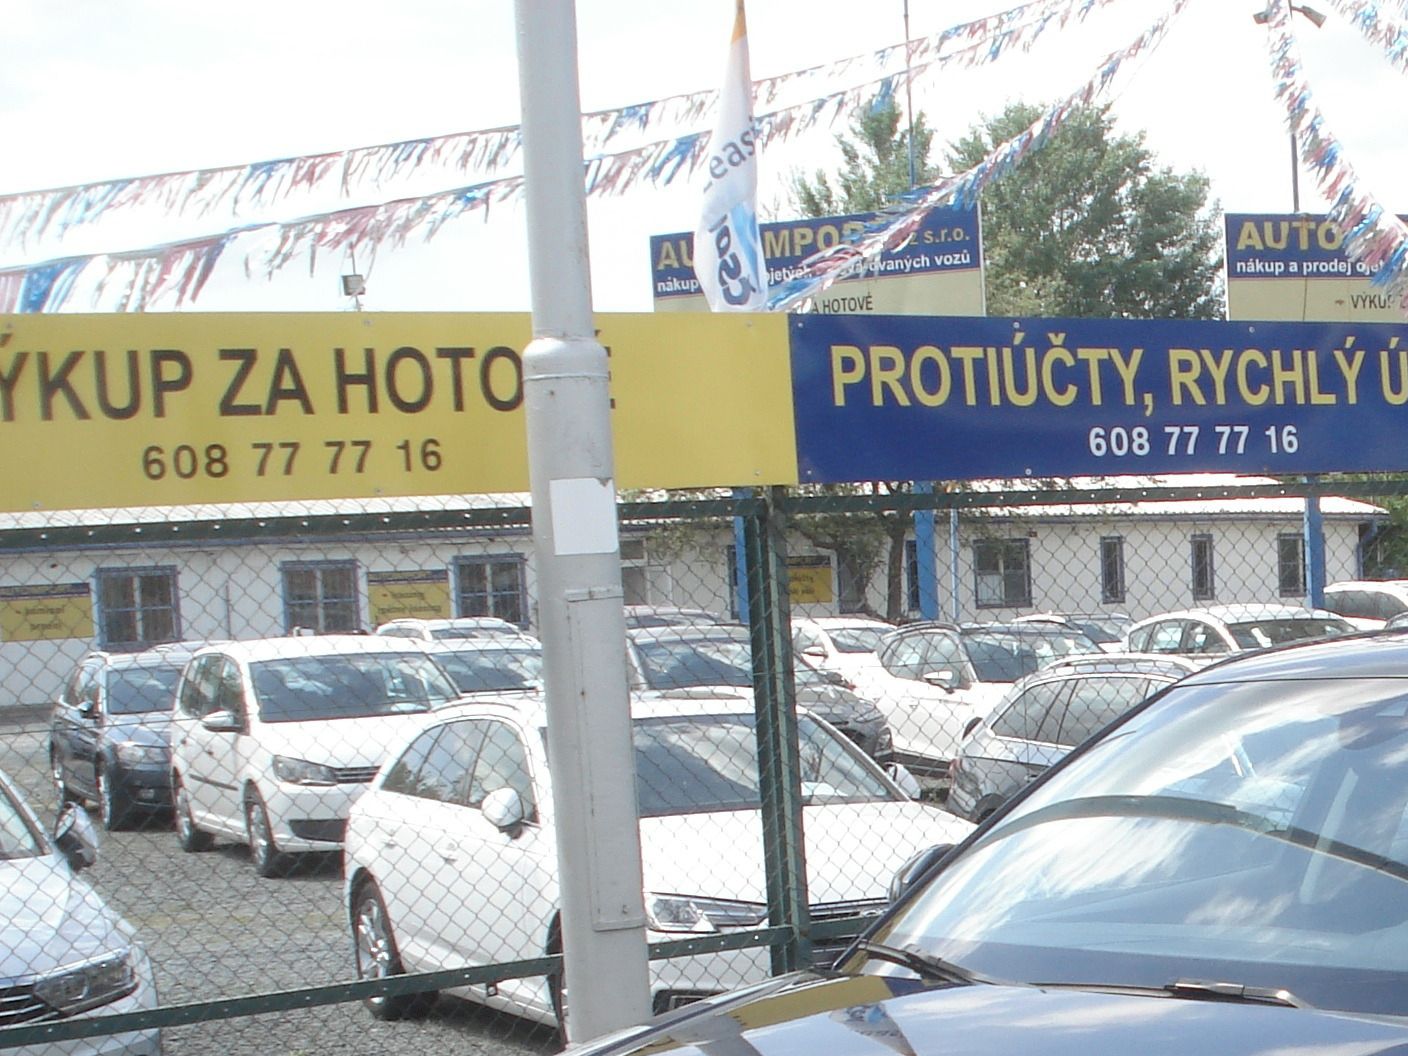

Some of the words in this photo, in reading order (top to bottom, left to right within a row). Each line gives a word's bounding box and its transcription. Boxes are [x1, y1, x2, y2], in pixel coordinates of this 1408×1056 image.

[923, 227, 971, 244] s.r.o.
[657, 275, 700, 293] nákup
[934, 250, 971, 266] vozů
[1236, 258, 1284, 275] nákup
[1289, 262, 1299, 273] a
[1303, 258, 1352, 276] prodej
[822, 291, 873, 314] HOTOVÉ
[218, 347, 315, 417] ZA
[335, 330, 617, 415] HOTO
[831, 332, 1155, 416] PROTIÚČTY,
[1169, 336, 1363, 406] RYCHLÝ
[142, 443, 230, 480] 608
[251, 441, 302, 477] 77
[323, 439, 373, 475] 77
[396, 437, 443, 473] 16
[1089, 426, 1152, 458] 608
[1164, 426, 1201, 457] 77
[1215, 425, 1251, 456] 77
[1264, 424, 1299, 455] 16
